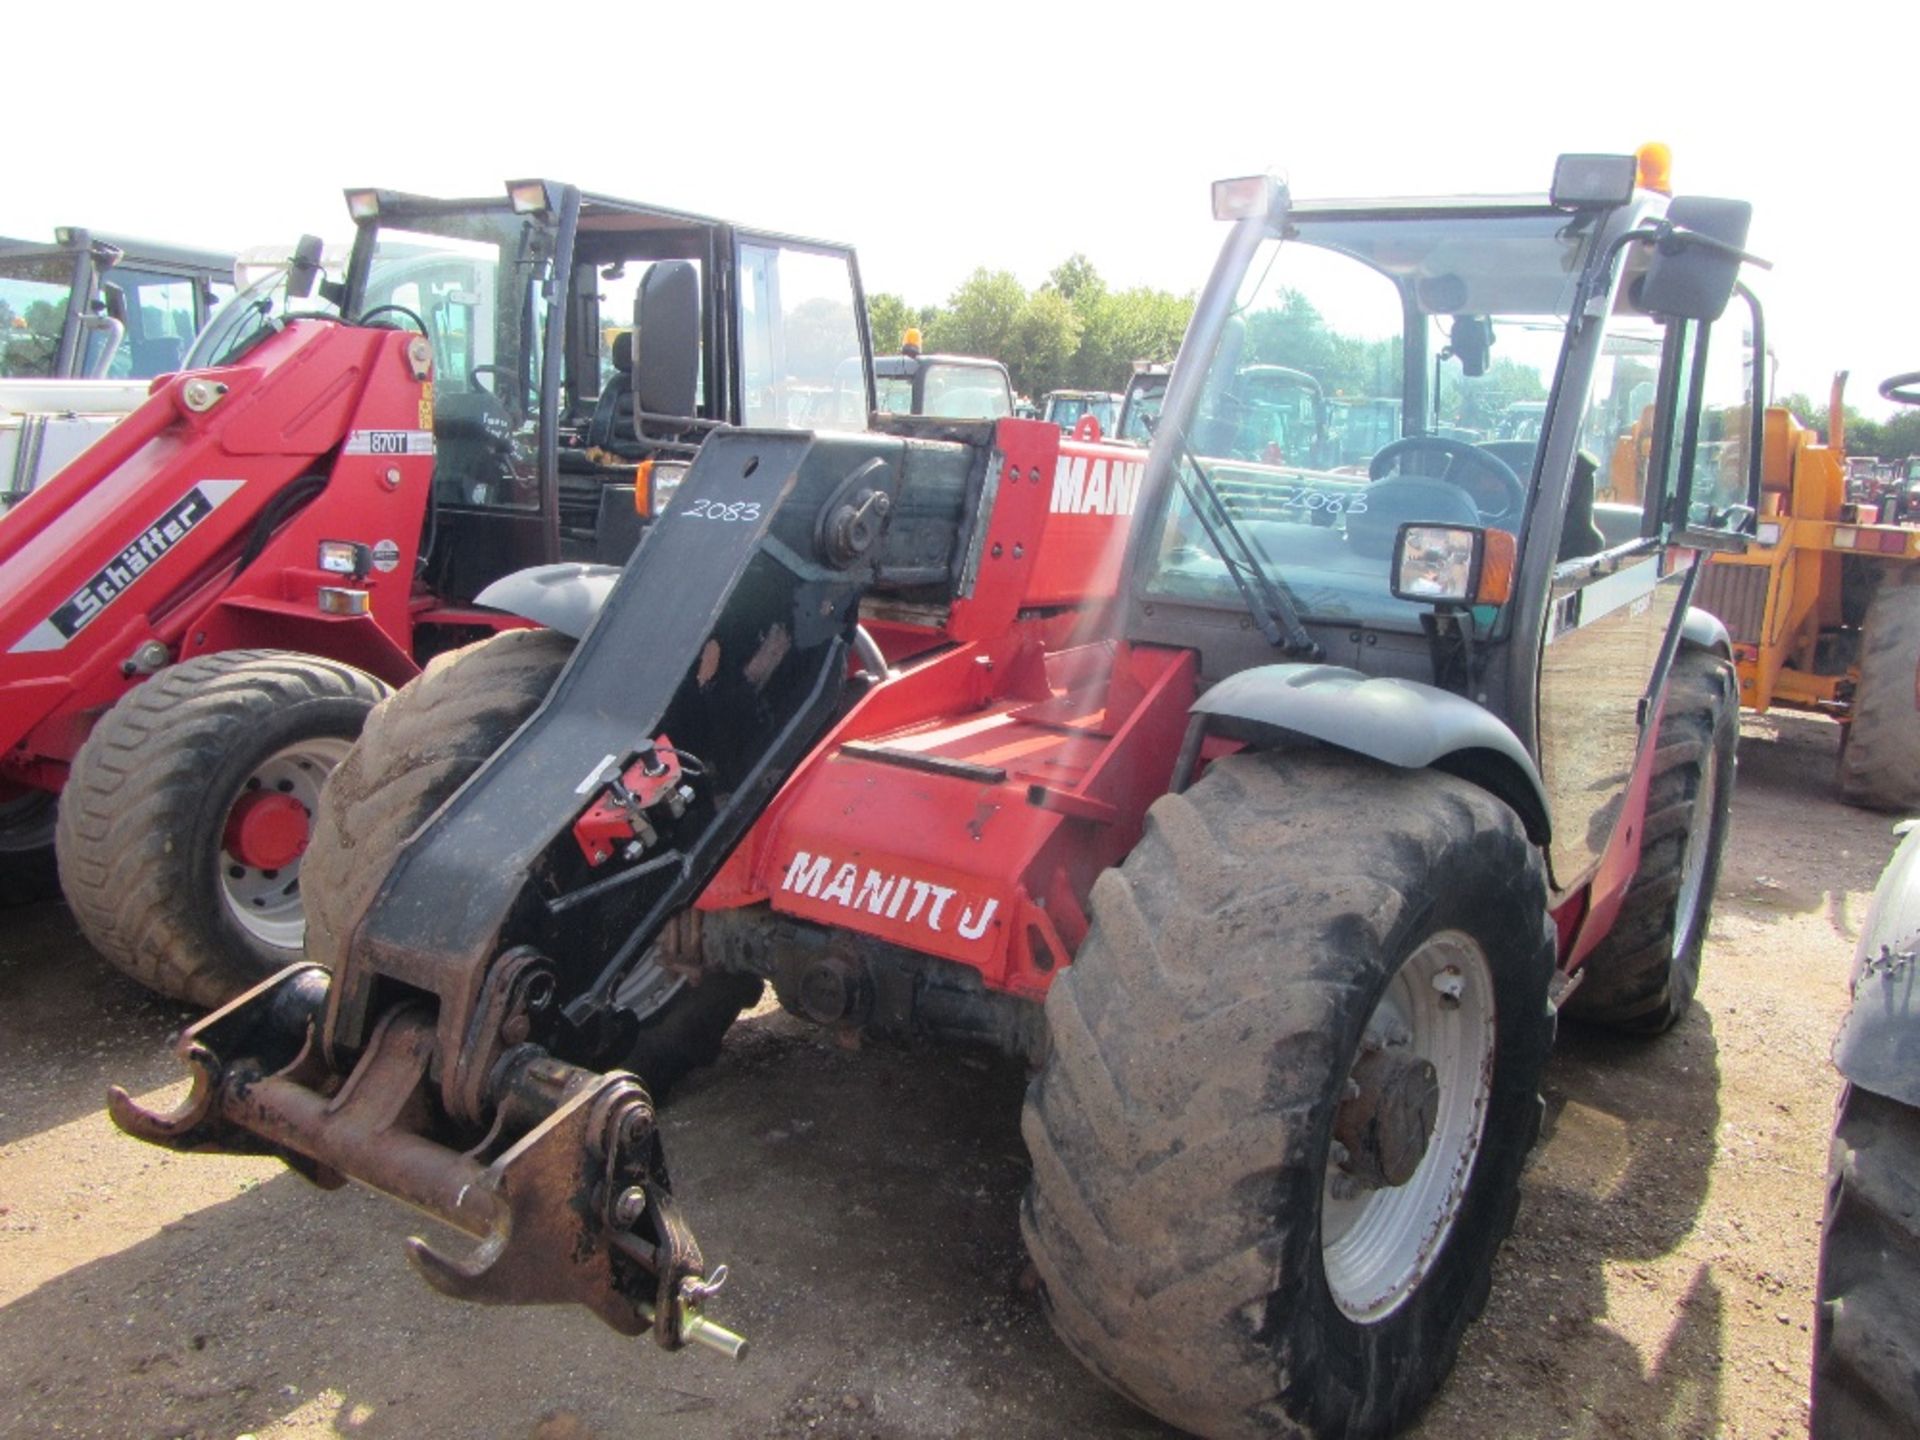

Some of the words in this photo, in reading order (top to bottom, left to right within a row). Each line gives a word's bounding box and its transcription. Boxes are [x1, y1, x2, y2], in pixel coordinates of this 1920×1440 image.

[371, 433, 406, 453] 870T
[680, 498, 761, 521] 2083
[1282, 486, 1368, 513] 2083
[73, 502, 196, 628] Schäffer
